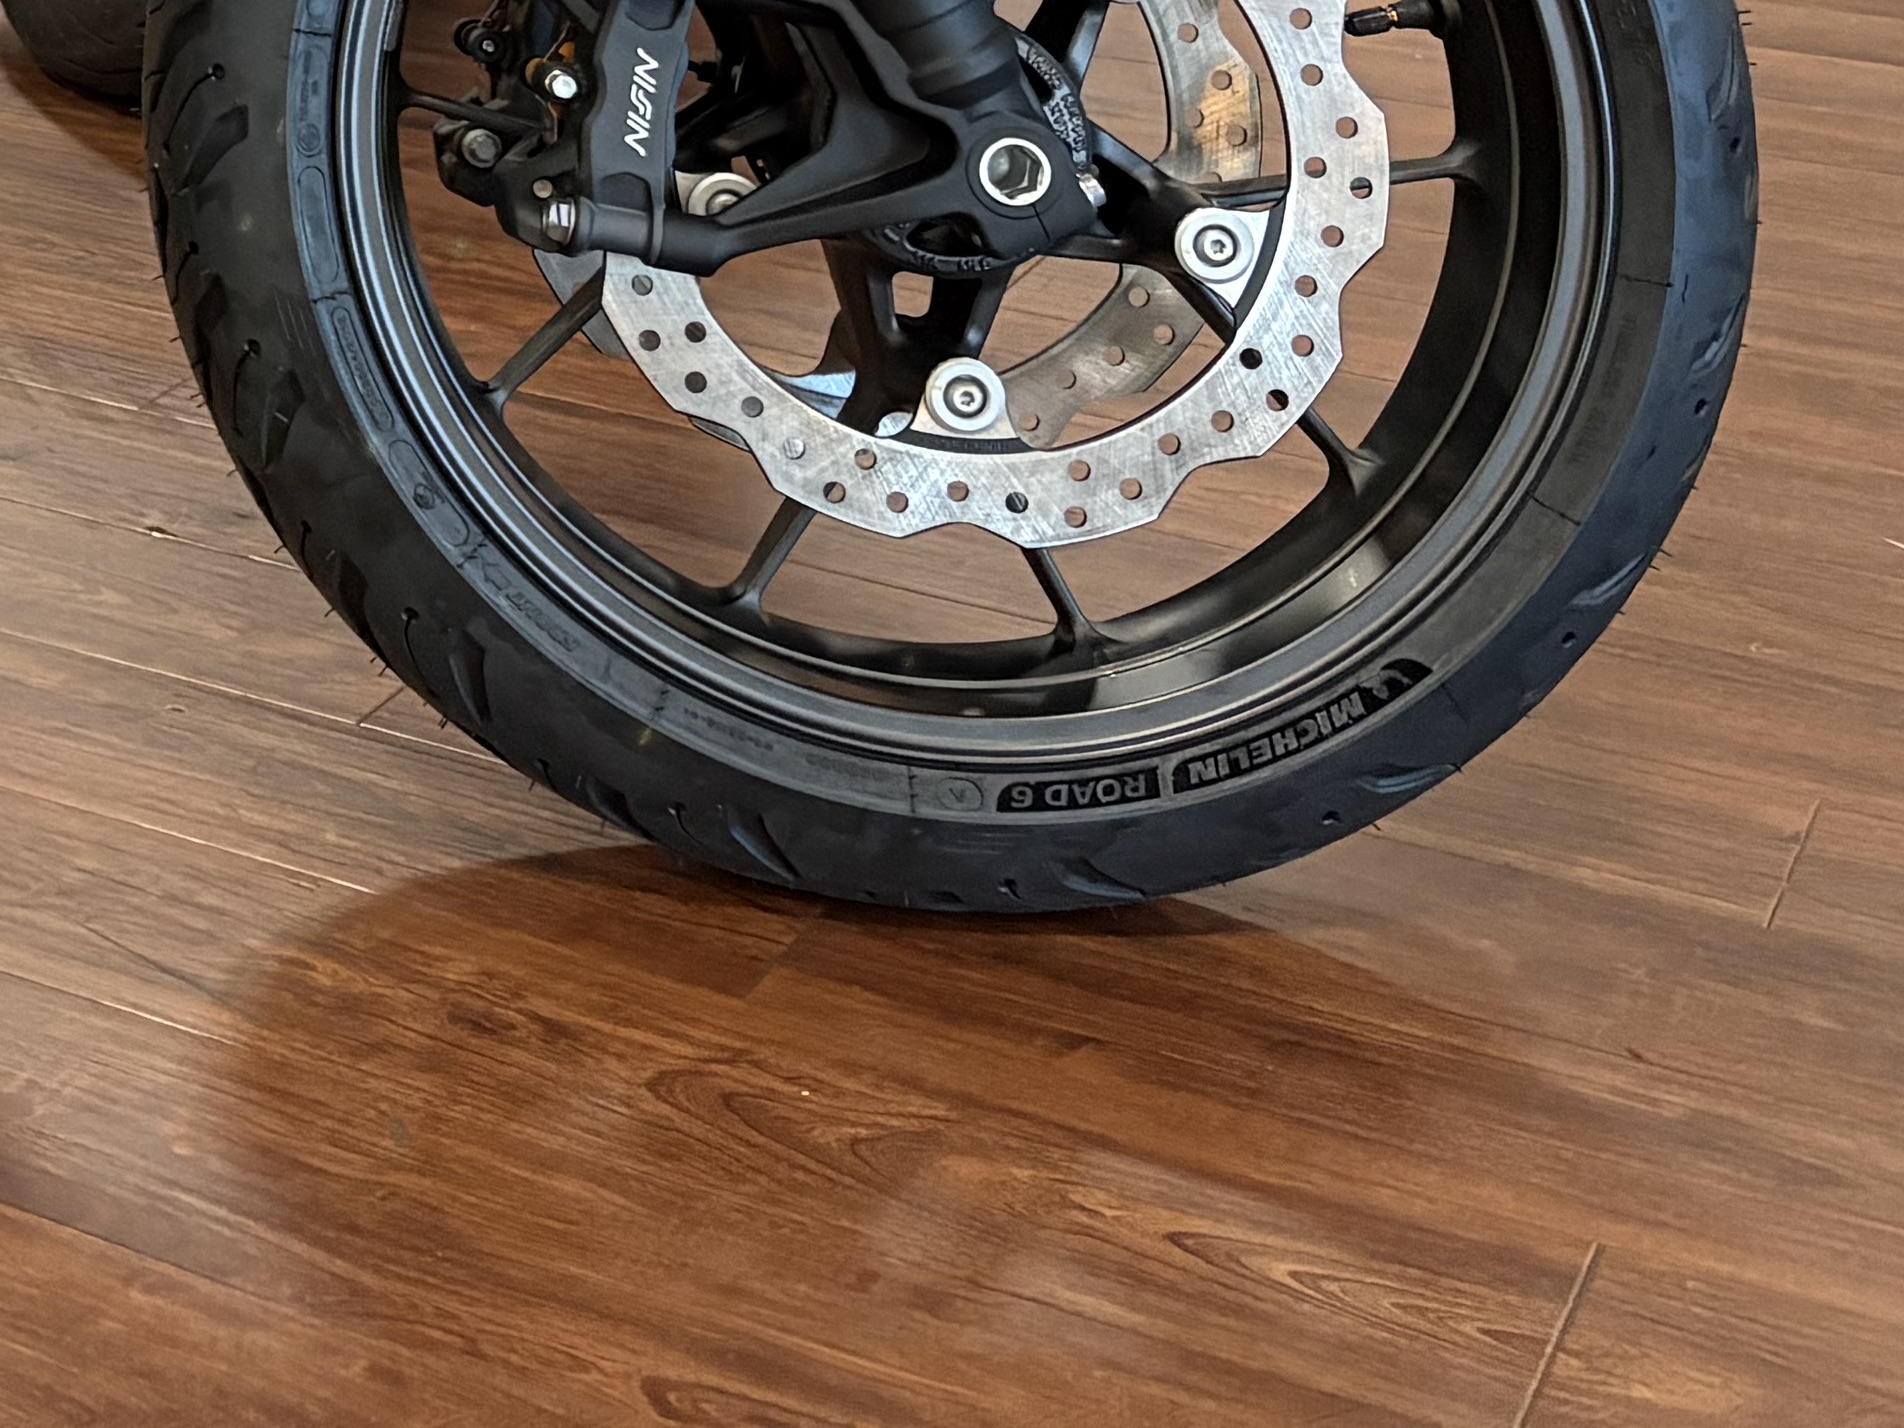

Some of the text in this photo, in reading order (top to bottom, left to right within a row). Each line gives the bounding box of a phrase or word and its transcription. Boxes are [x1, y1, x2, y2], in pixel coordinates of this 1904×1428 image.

[1011, 697, 1367, 809] MICHELIN ROAD 6
